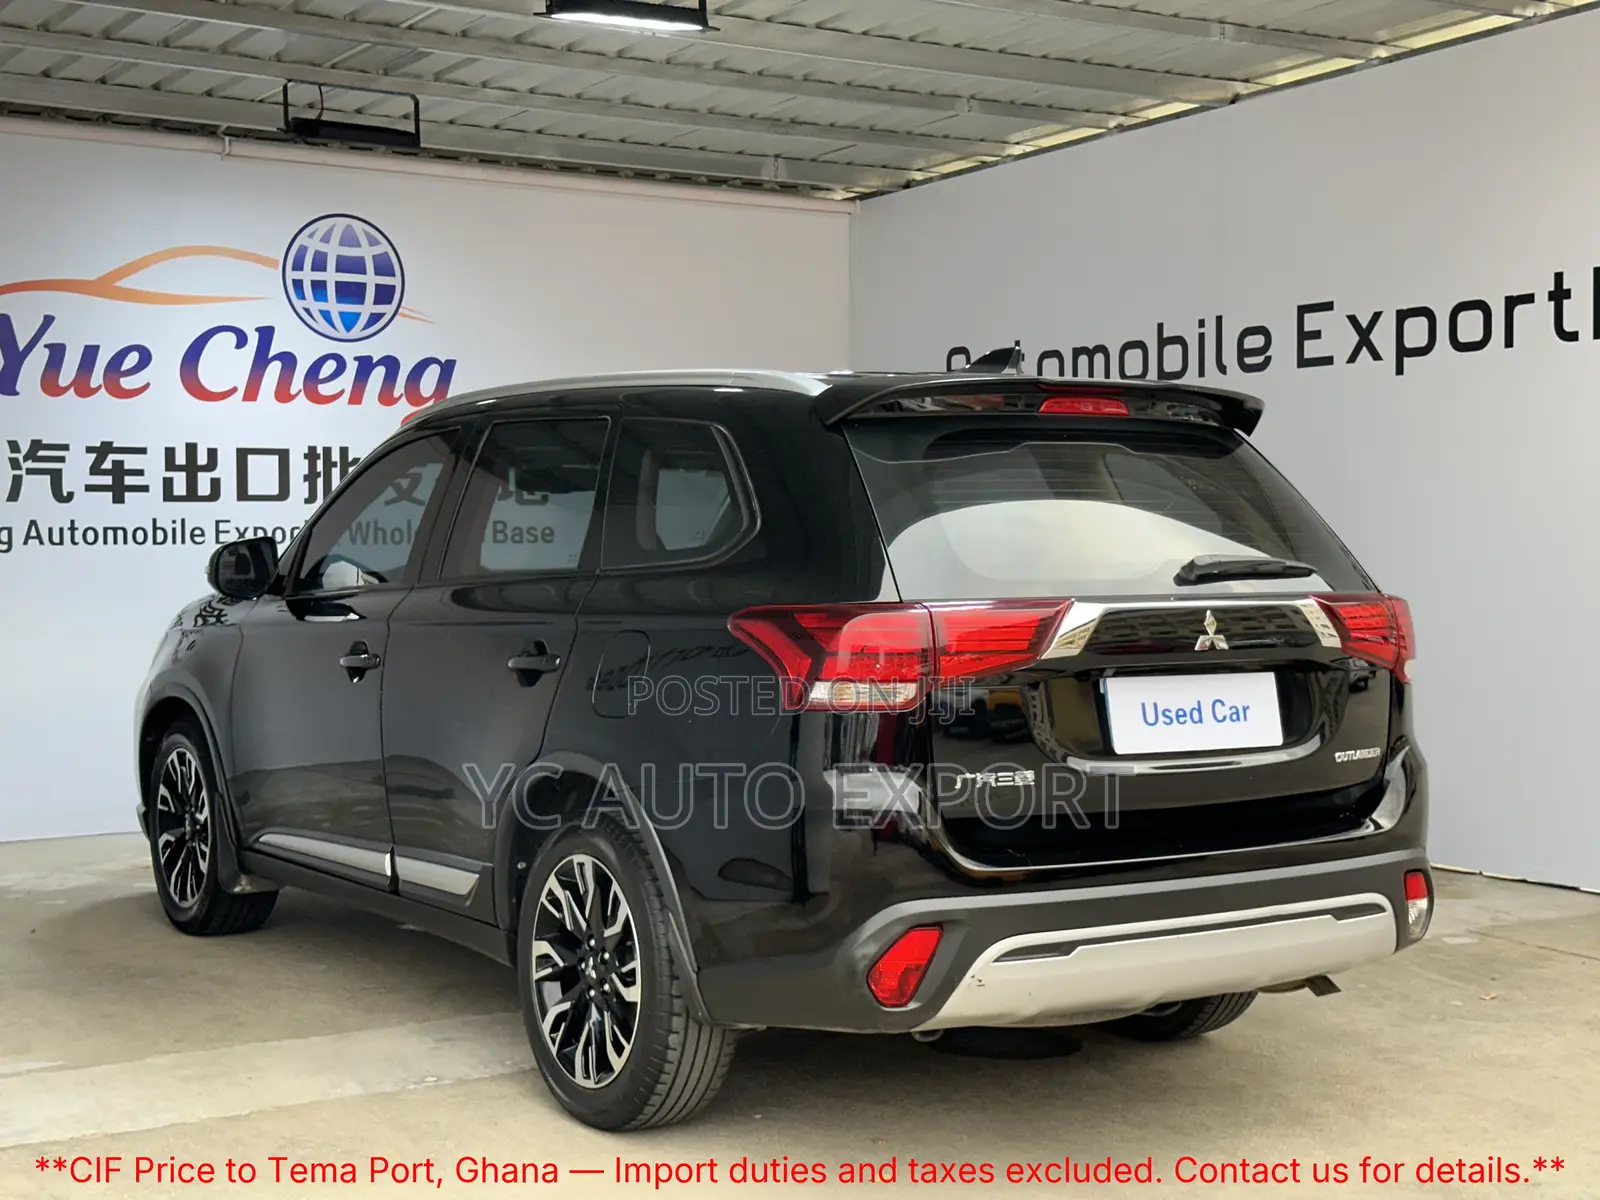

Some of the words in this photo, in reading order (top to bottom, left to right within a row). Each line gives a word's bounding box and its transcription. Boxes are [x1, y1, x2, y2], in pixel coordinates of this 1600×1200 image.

[0, 313, 153, 399] Yue
[180, 325, 457, 425] Cheng
[23, 518, 206, 547] Automobile
[493, 520, 555, 545] Base
[1141, 700, 1204, 727] Used
[1211, 698, 1250, 723] Car
[1334, 746, 1381, 763] OUTLANDER
